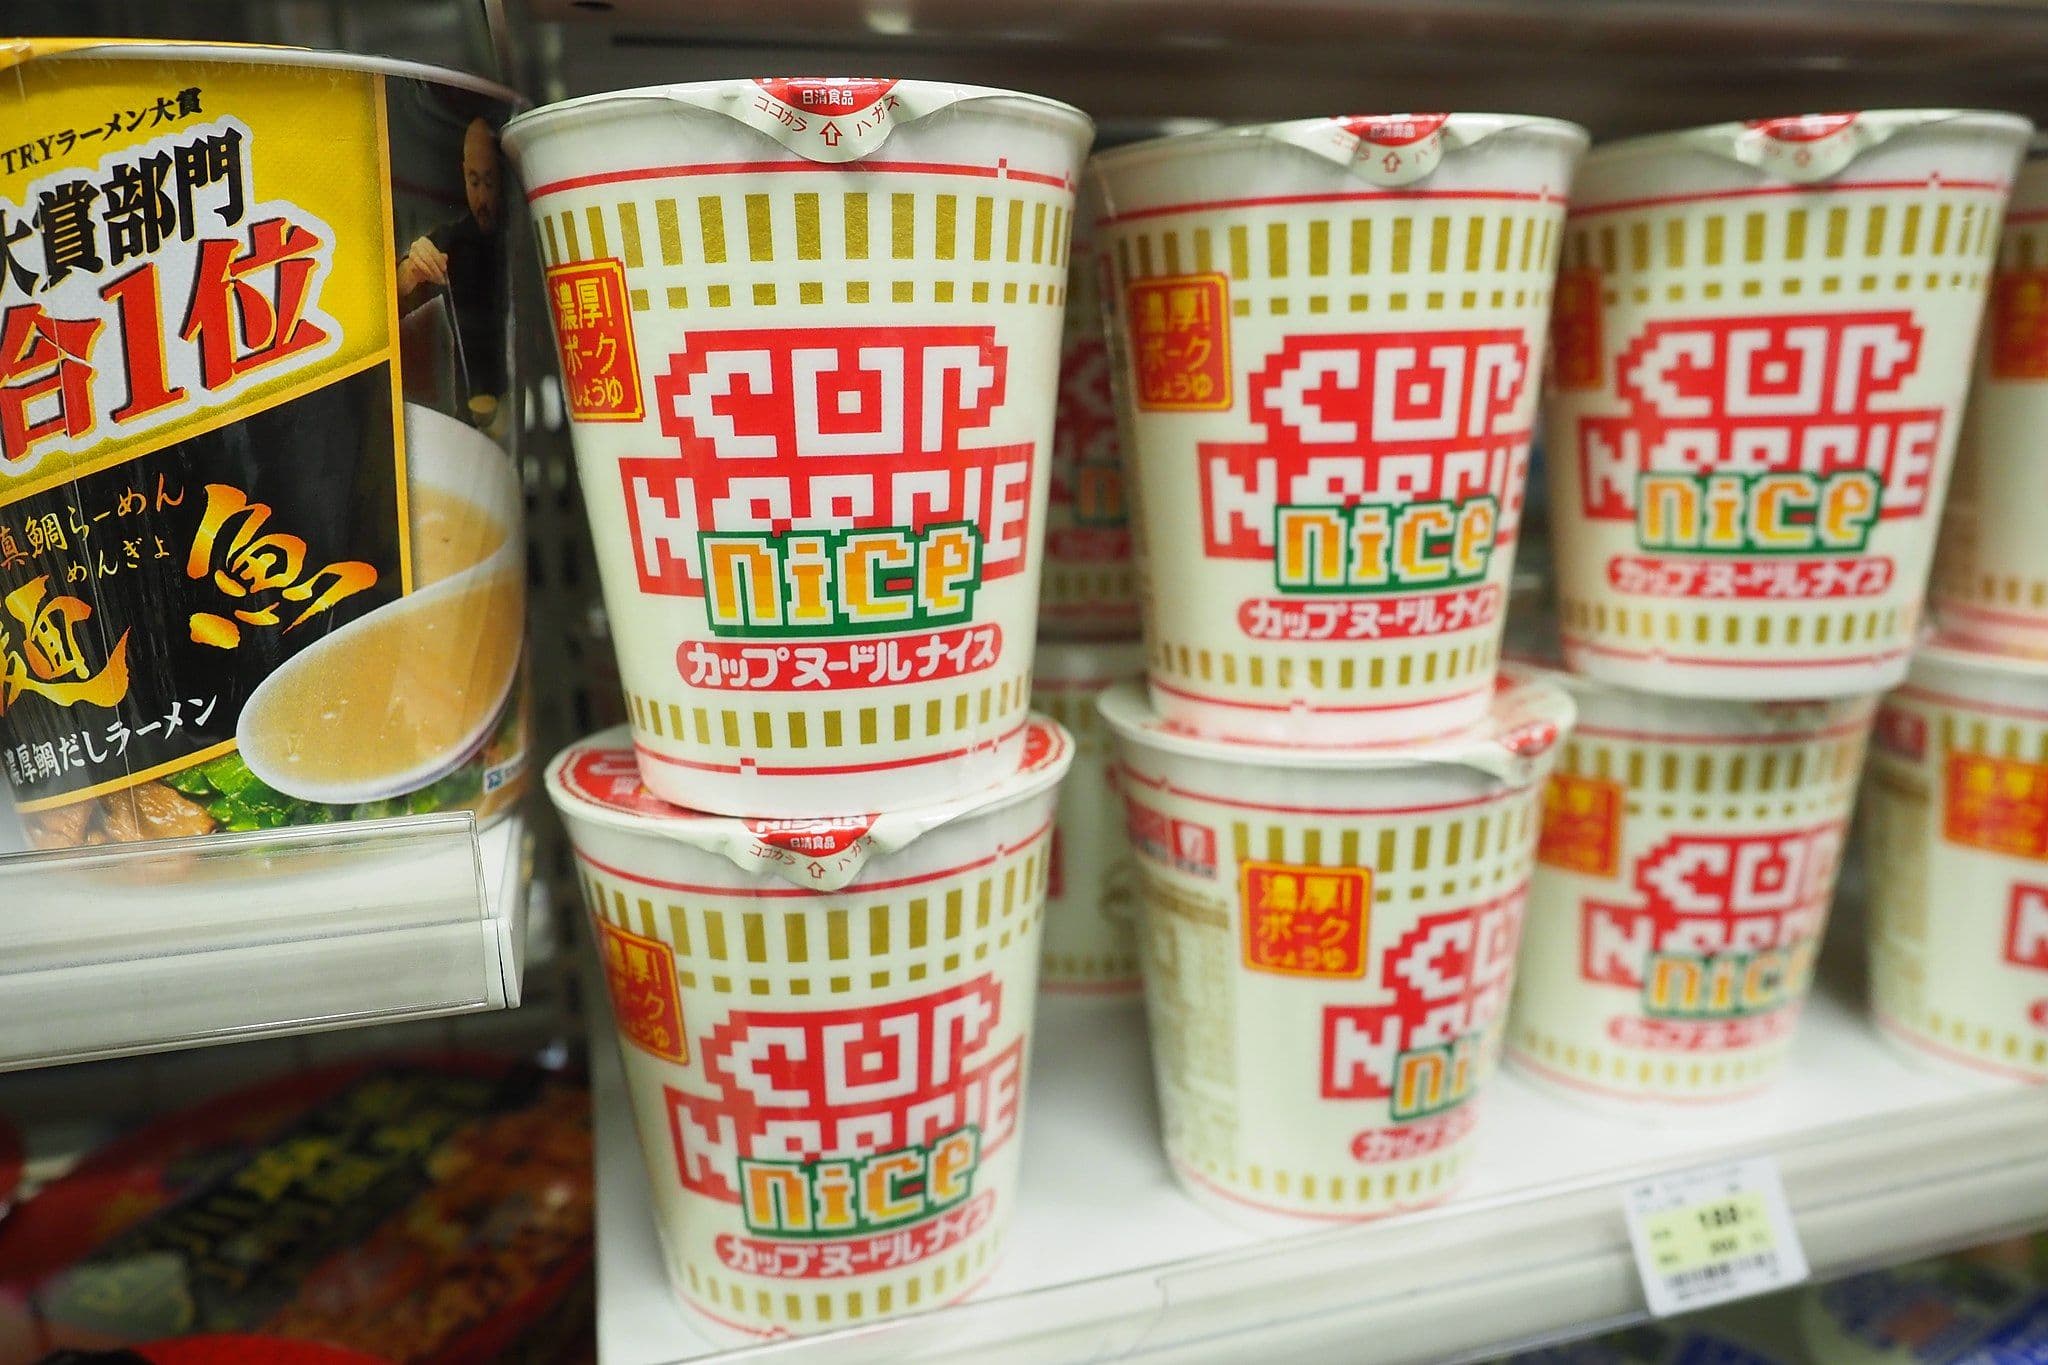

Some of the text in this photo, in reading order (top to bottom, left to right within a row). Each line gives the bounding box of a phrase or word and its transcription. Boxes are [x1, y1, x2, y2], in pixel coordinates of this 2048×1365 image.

[754, 94, 900, 137] ココカラ ハガス
[802, 89, 853, 106] 日清食品
[564, 332, 617, 376] ポーク
[1627, 325, 1911, 417] CUP
[572, 376, 624, 408] しょうゆ
[673, 346, 995, 458] CUP
[1263, 343, 1523, 443] CUP
[0, 473, 184, 571] 真鯛らーめん
[66, 535, 170, 583] めんぎょ
[687, 630, 996, 687] カップヌードルナイス
[717, 991, 993, 1108] CUP
